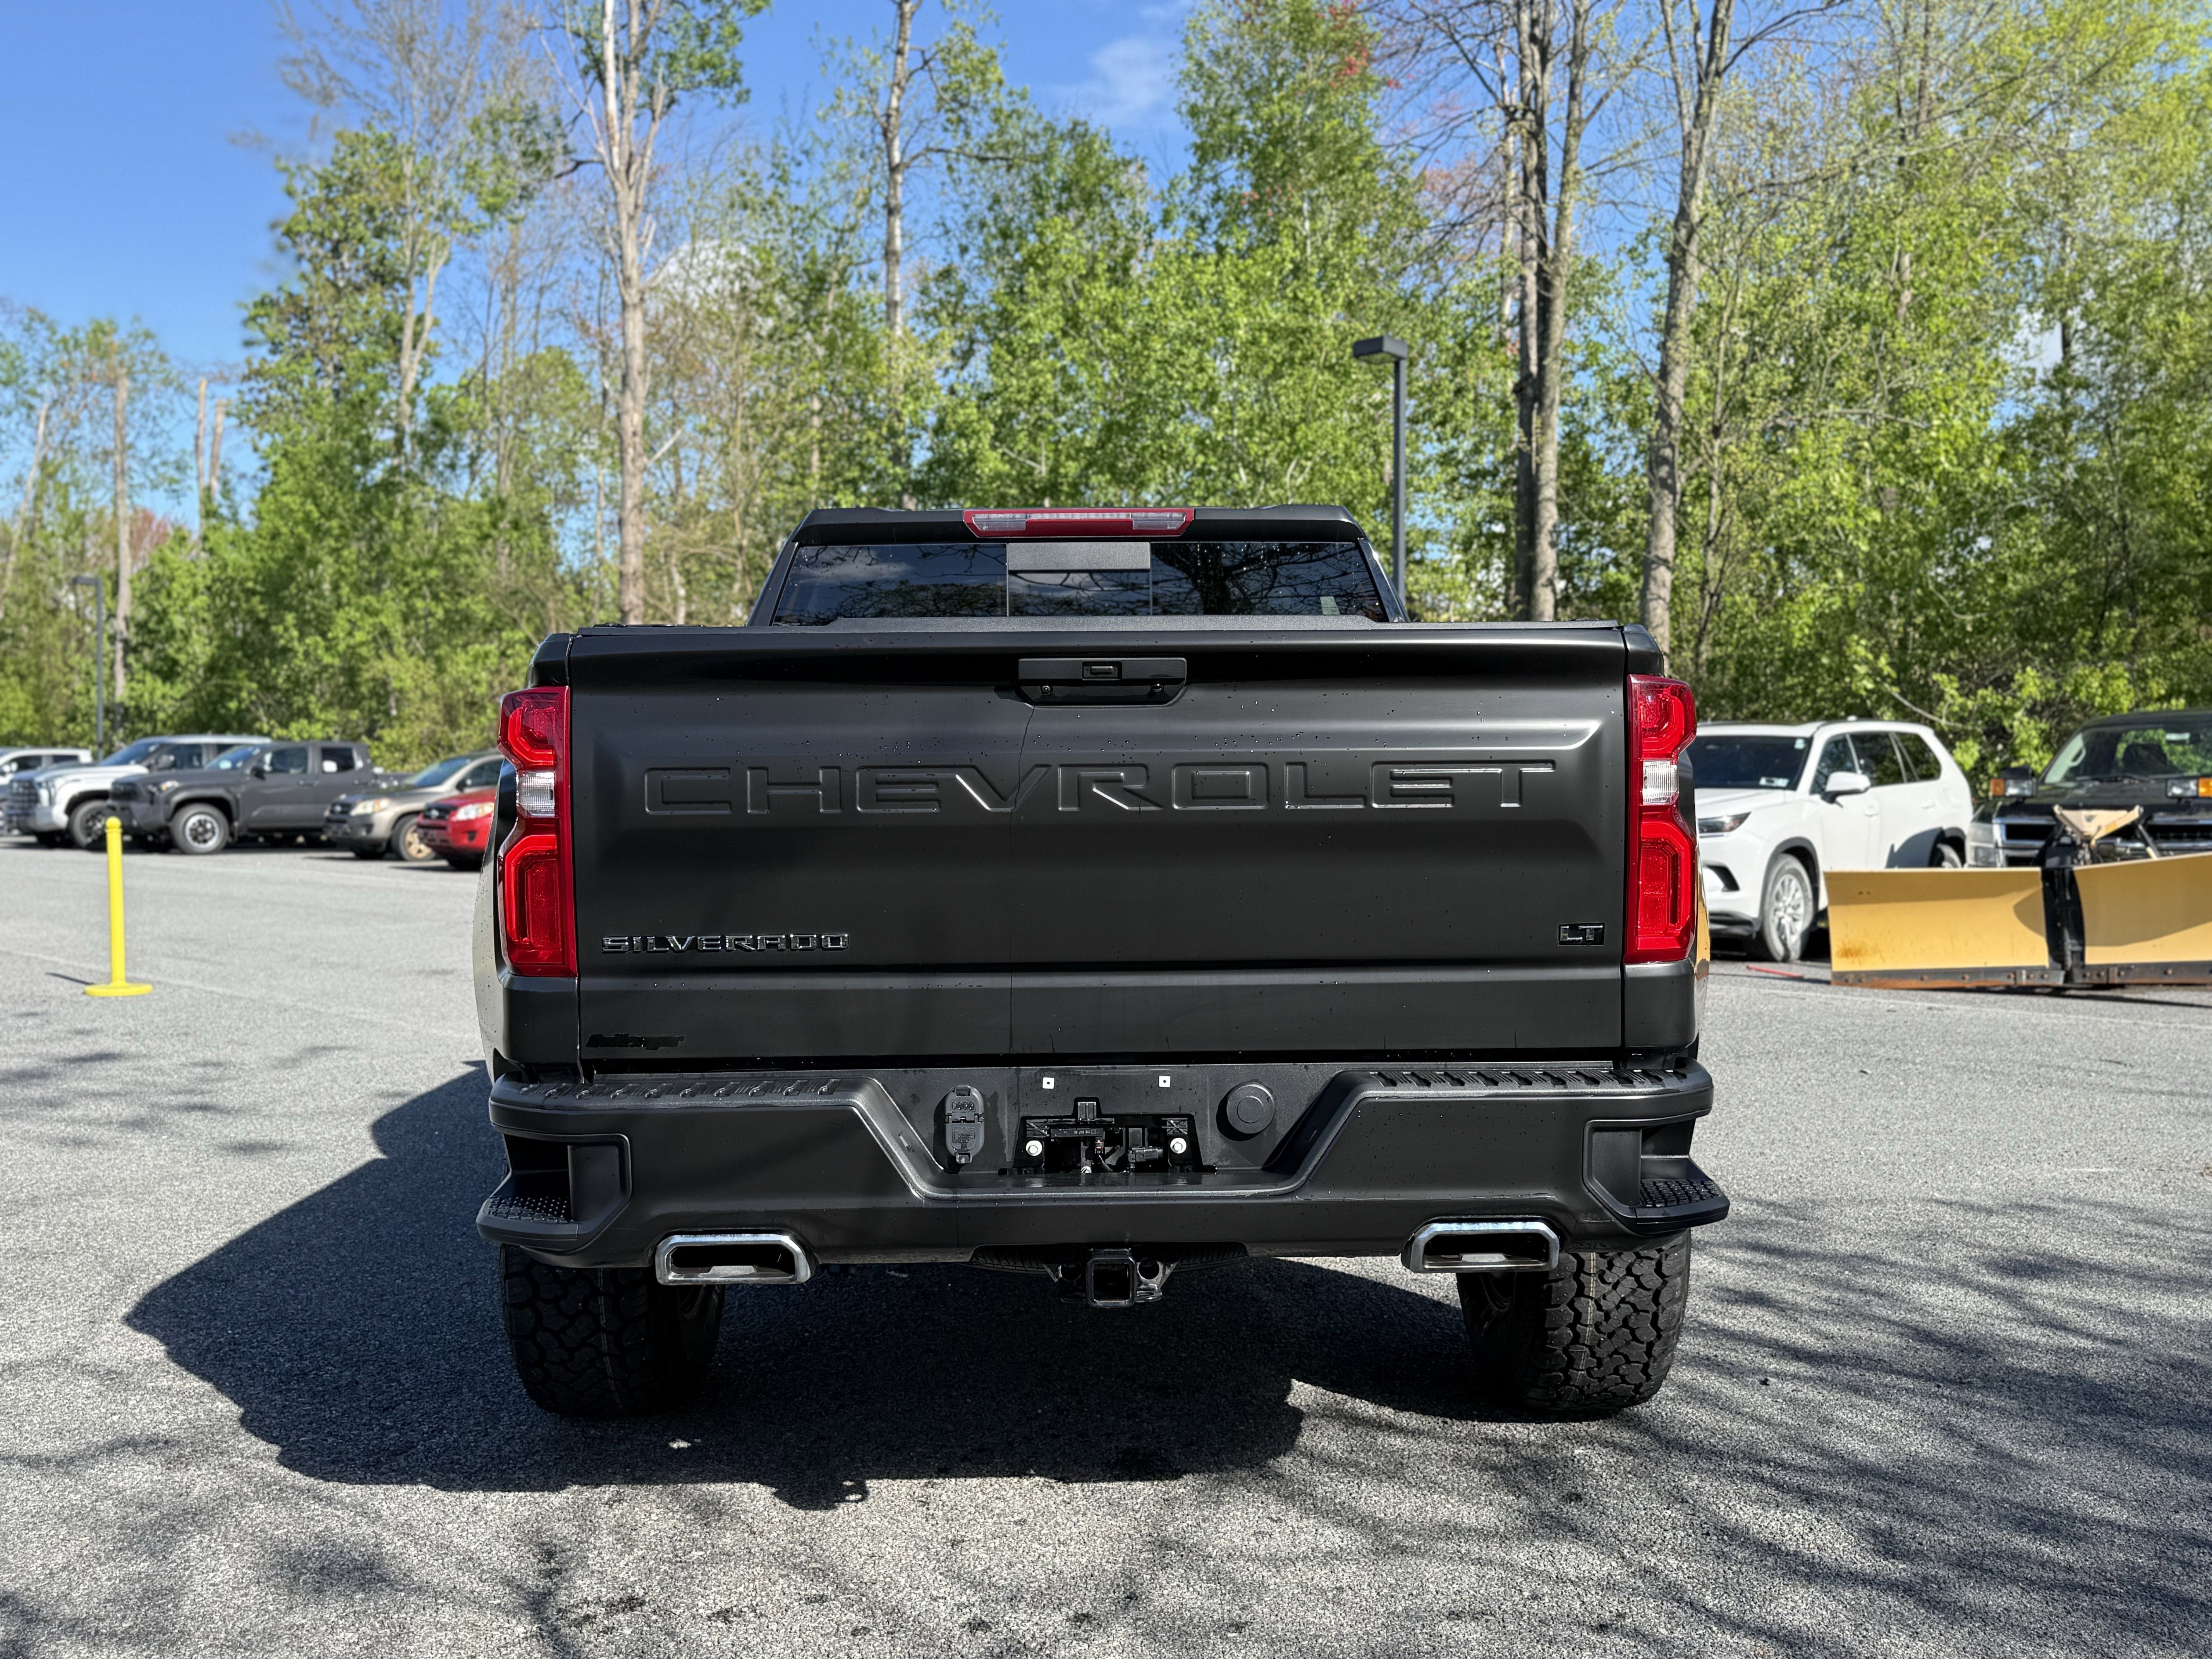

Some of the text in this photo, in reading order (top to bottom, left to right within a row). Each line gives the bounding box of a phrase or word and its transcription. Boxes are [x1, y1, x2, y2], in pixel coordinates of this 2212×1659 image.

[644, 760, 1556, 815] CHEVROLET
[601, 933, 850, 953] SILVERADO
[1559, 924, 1604, 942] LT
